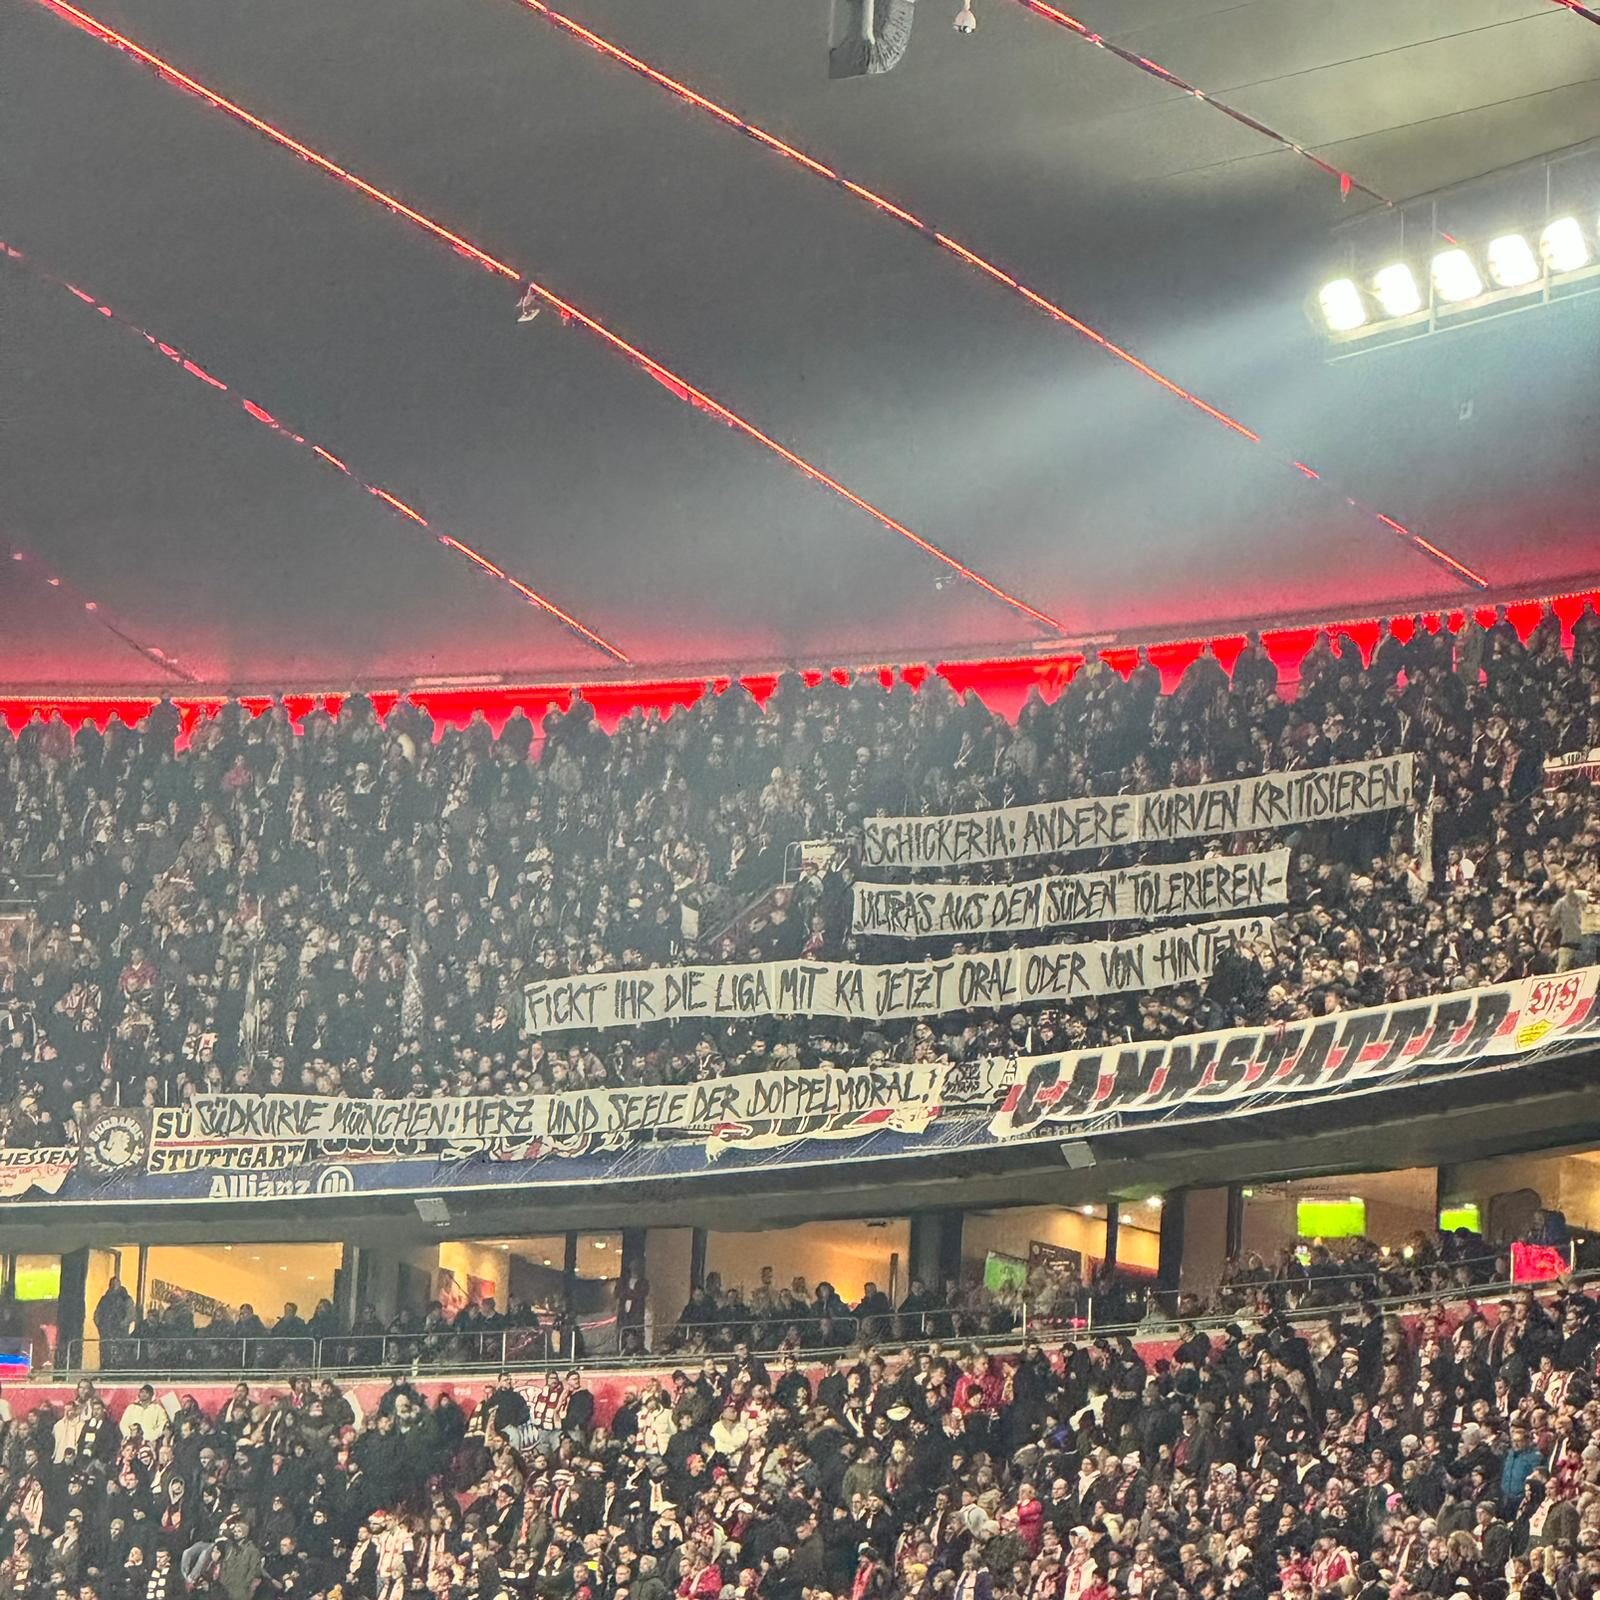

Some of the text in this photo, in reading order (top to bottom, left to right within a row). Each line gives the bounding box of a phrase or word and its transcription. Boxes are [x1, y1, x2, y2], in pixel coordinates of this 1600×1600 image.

[1024, 801, 1130, 854] ANDERE
[1141, 782, 1240, 838] KURVEN
[939, 891, 990, 931] AUS
[991, 883, 1042, 928] DEM
[526, 981, 607, 1030] FICKT
[614, 979, 656, 1020] IHR
[663, 970, 706, 1013] DIE
[715, 970, 769, 1014] LIGA
[779, 966, 828, 1012] MIT
[836, 967, 865, 1012] KA
[875, 962, 956, 1016] JETZT
[958, 957, 1017, 1003] ORAL
[1025, 953, 1089, 996] ODER
[1101, 943, 1145, 989] VON
[1012, 990, 1512, 1129] CANNSTATTER
[460, 1098, 534, 1136] HERZ
[548, 1096, 599, 1136] UND
[607, 1091, 688, 1130] SEELE
[690, 1084, 742, 1124] DER
[748, 1070, 938, 1117] DOPPELMORAL!
[150, 1144, 305, 1173] STUTTGART
[209, 1173, 311, 1199] Allianz
